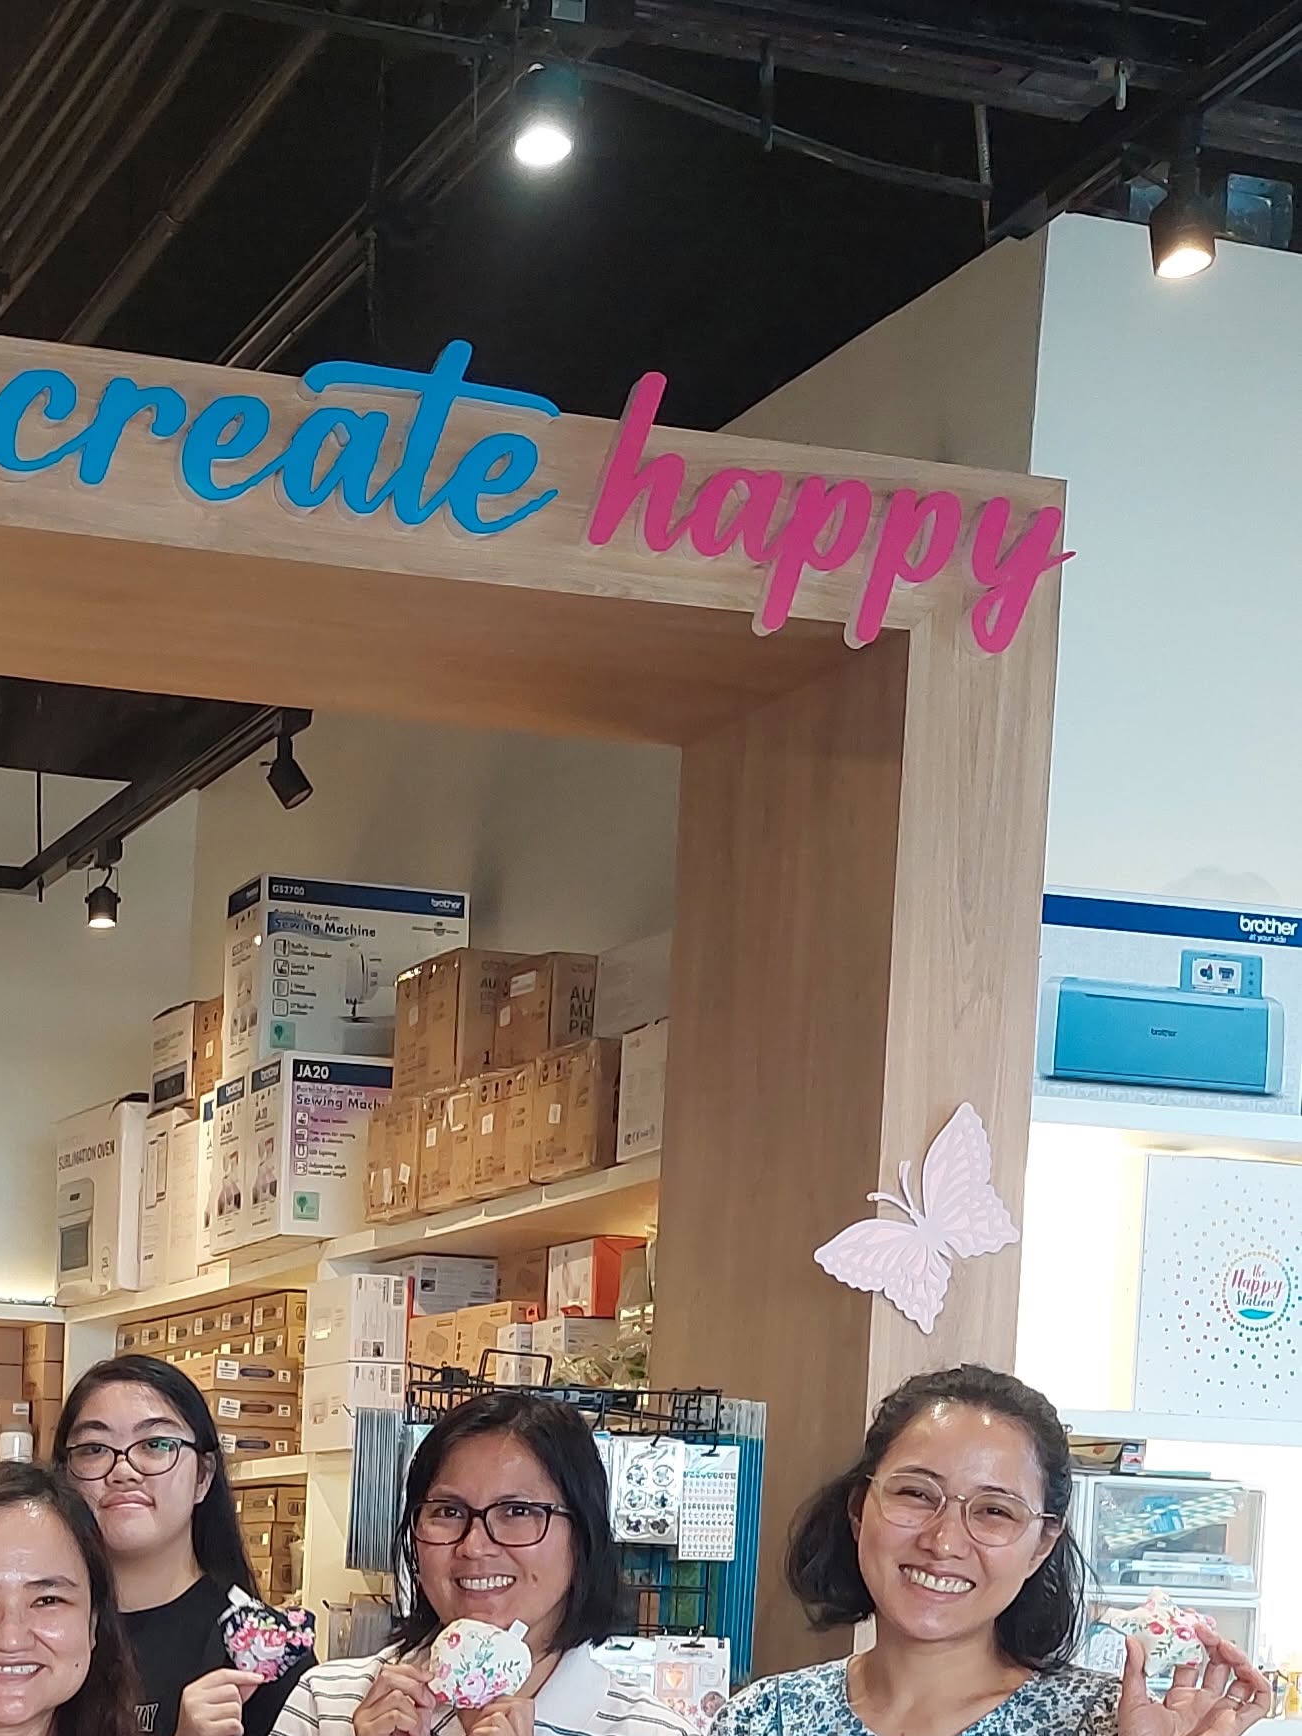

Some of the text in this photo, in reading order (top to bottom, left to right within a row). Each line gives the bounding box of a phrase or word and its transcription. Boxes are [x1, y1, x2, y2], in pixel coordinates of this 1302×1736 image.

[588, 371, 1076, 655] happy
[275, 917, 376, 938] Sewing Machine
[1239, 914, 1298, 936] brother
[296, 1064, 330, 1079] JA20
[296, 1094, 343, 1111] Sewing
[1231, 1269, 1284, 1300] Happy
[1235, 1290, 1274, 1308] Station
